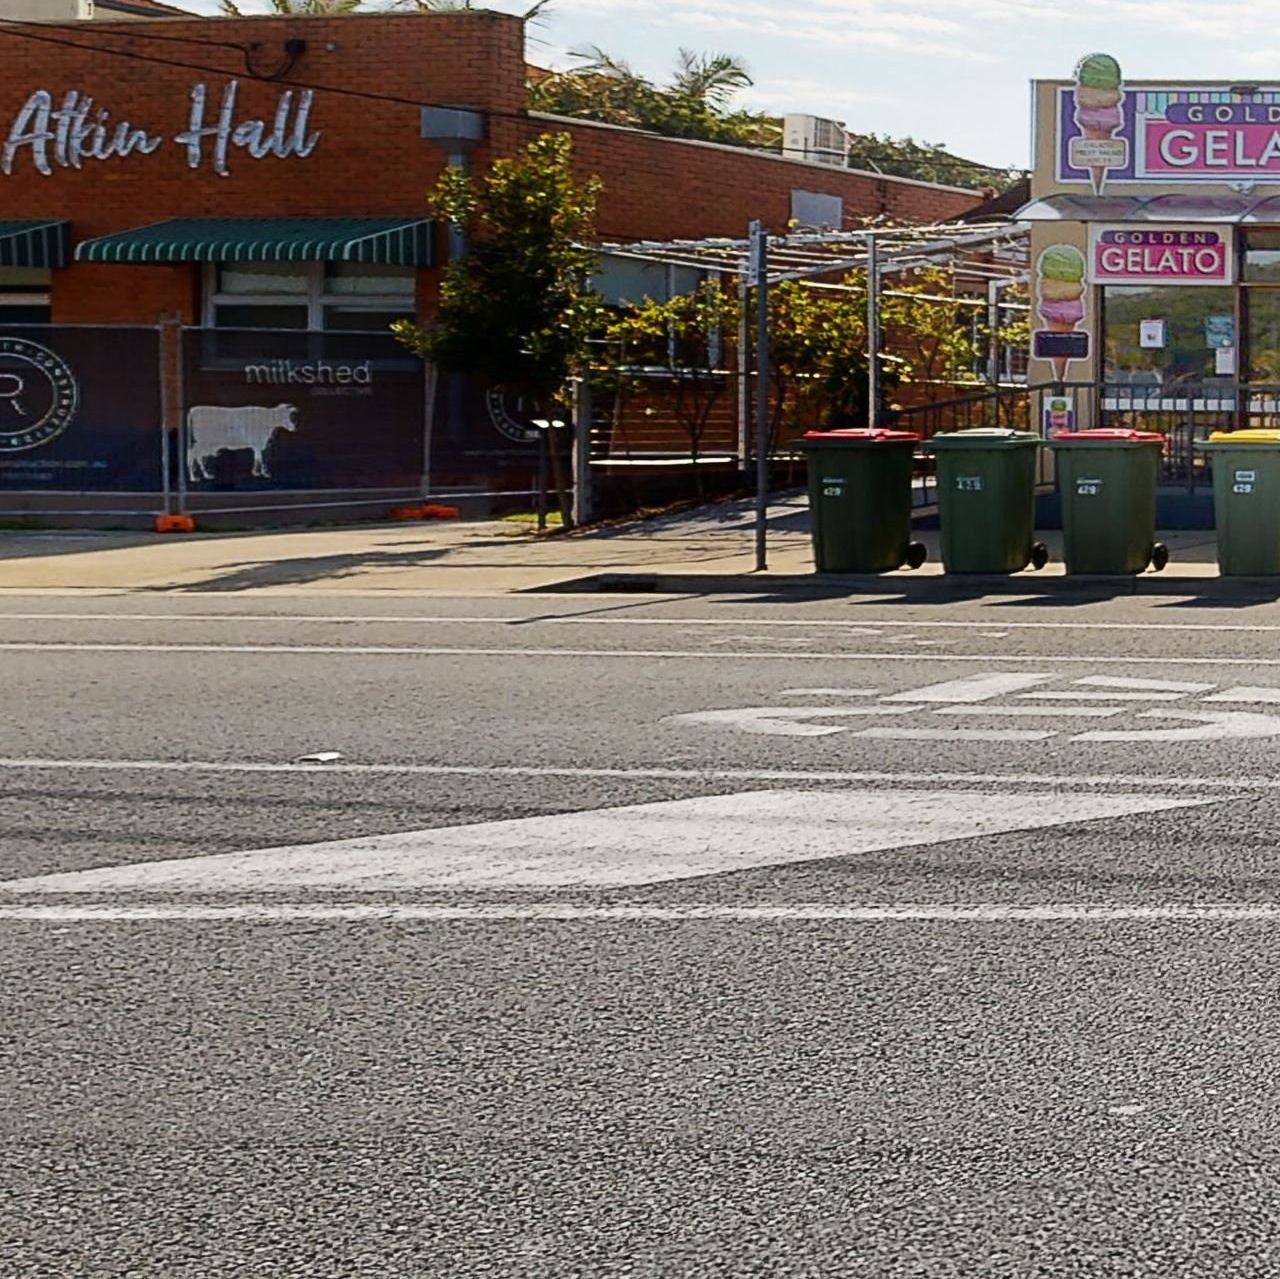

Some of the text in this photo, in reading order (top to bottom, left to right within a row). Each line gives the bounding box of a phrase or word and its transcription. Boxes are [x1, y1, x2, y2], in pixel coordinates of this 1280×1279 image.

[3, 79, 321, 177] Atkin Hall
[1114, 232, 1209, 244] GOLDEN
[1101, 248, 1221, 274] GELATO
[243, 359, 373, 385] milkshed
